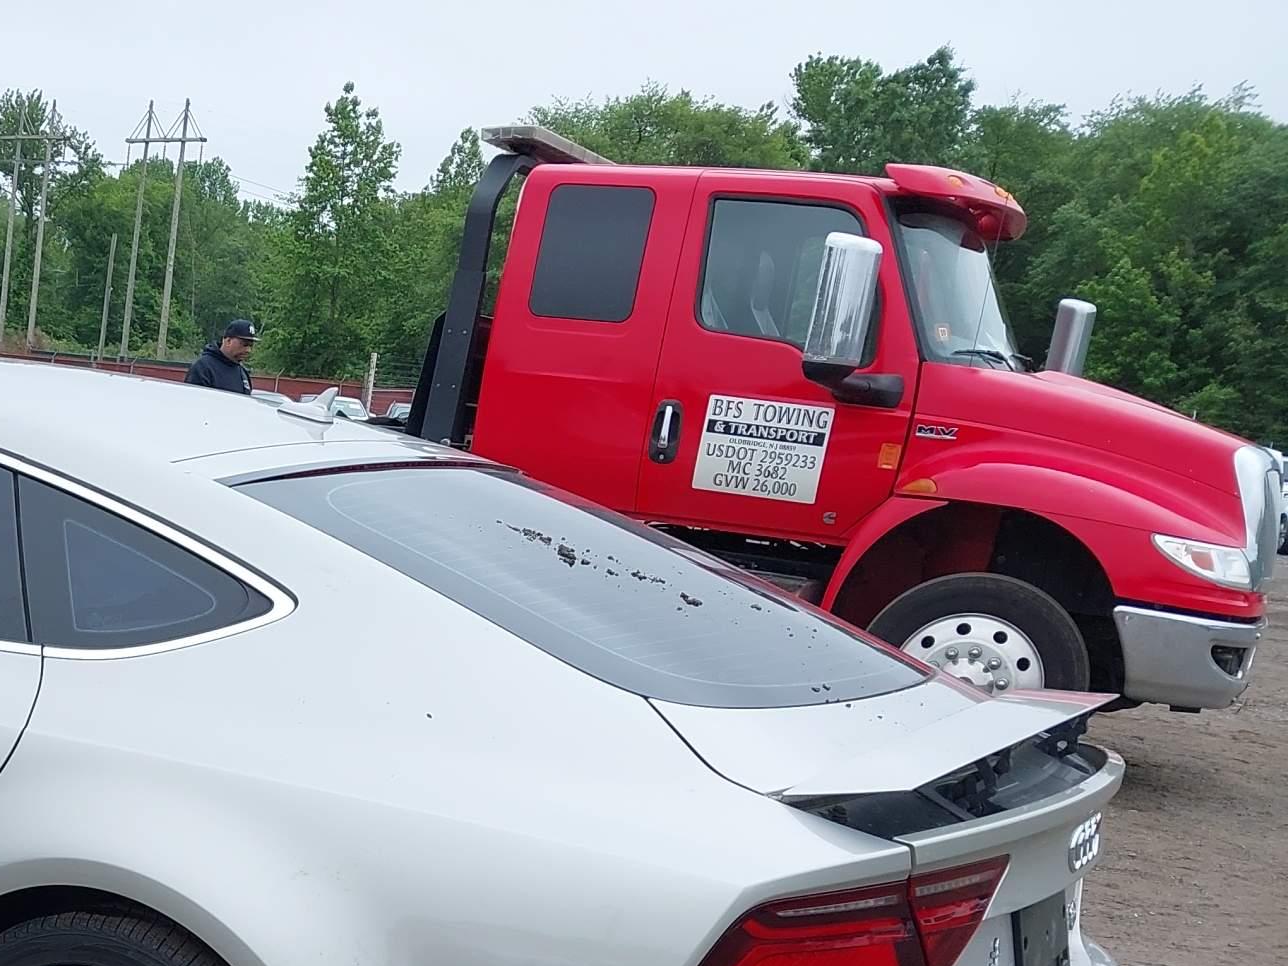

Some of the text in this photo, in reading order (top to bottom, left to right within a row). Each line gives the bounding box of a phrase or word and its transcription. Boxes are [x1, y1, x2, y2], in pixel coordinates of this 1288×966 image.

[712, 399, 829, 429] BFS TOWING
[714, 421, 818, 443] & TRANSPORT
[916, 424, 959, 439] MV
[706, 443, 817, 469] USDOT 2959233
[727, 460, 787, 480] MC 3682
[713, 473, 797, 496] GVW 26,000
